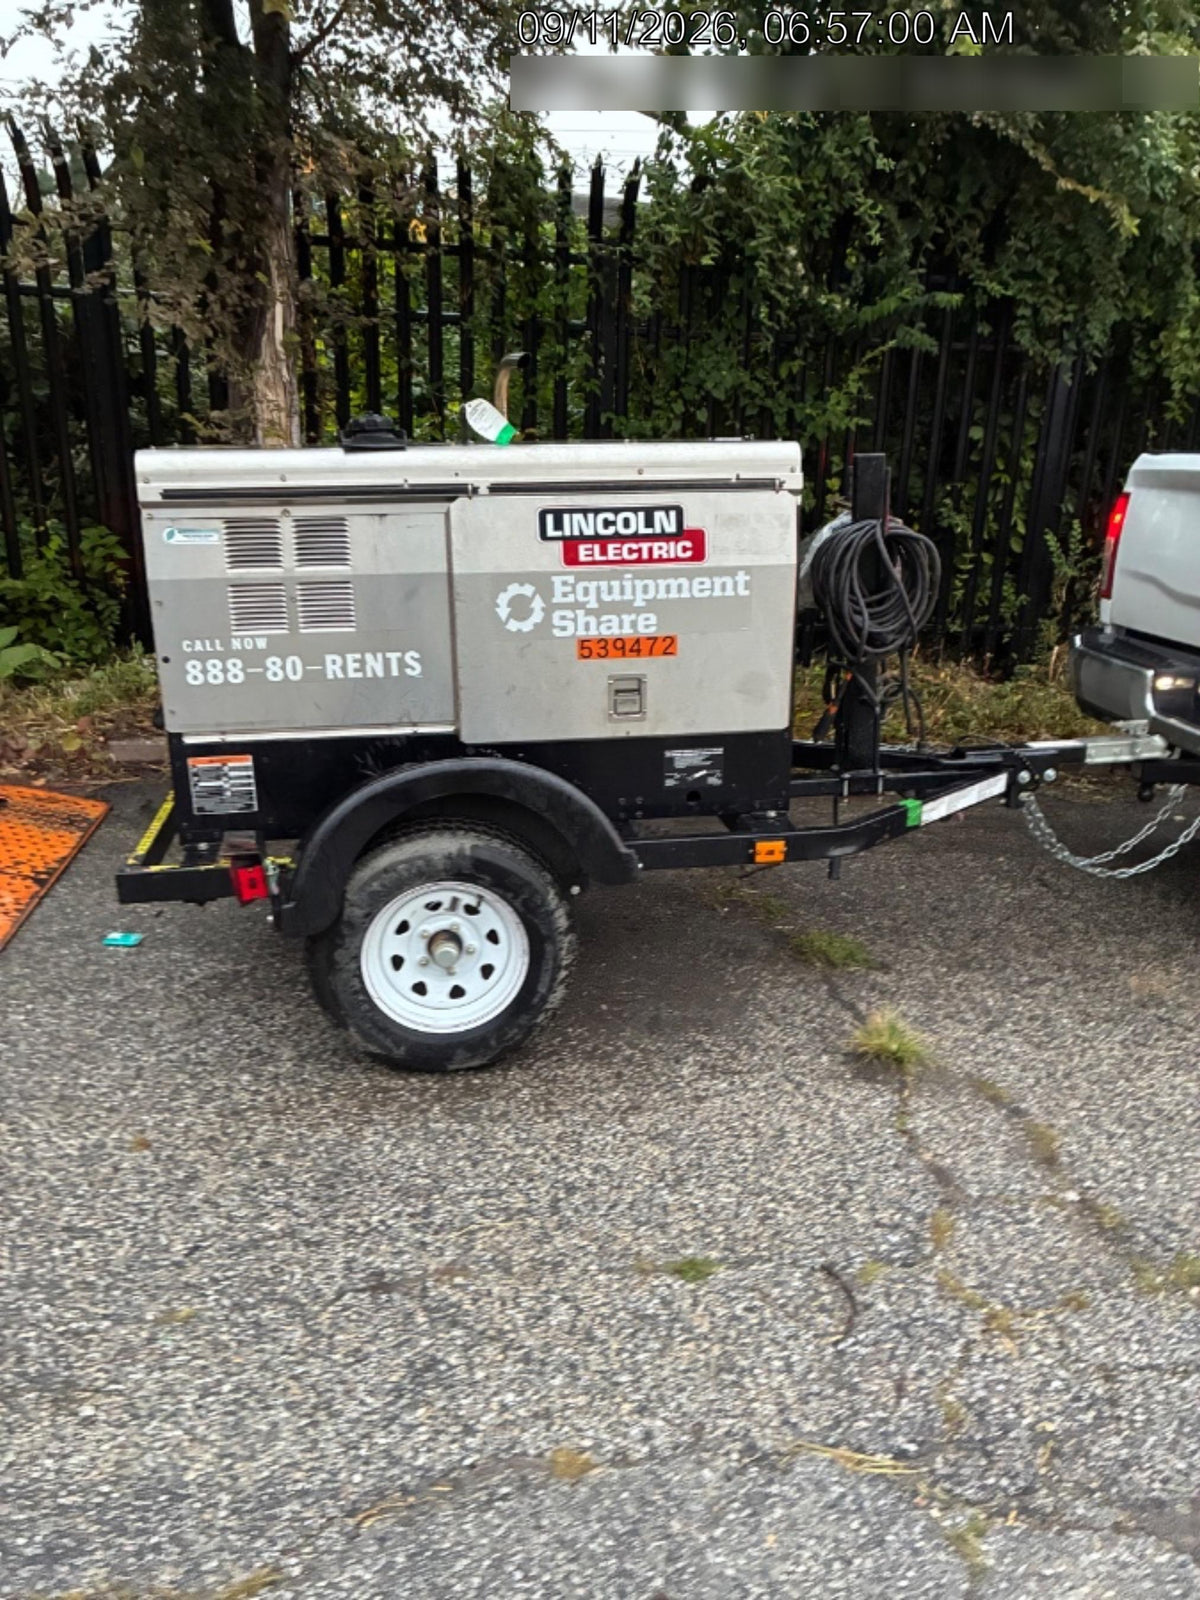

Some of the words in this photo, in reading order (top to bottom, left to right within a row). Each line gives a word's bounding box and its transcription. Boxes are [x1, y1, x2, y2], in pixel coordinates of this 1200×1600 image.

[545, 510, 678, 538] LINCOLN
[578, 540, 693, 562] ELECTRIC
[551, 570, 751, 609] Equipment
[552, 610, 658, 637] Share
[182, 639, 224, 652] CALL
[231, 637, 268, 651] NOW
[578, 636, 676, 659] 539472
[185, 650, 423, 686] 888-80-RENTS
